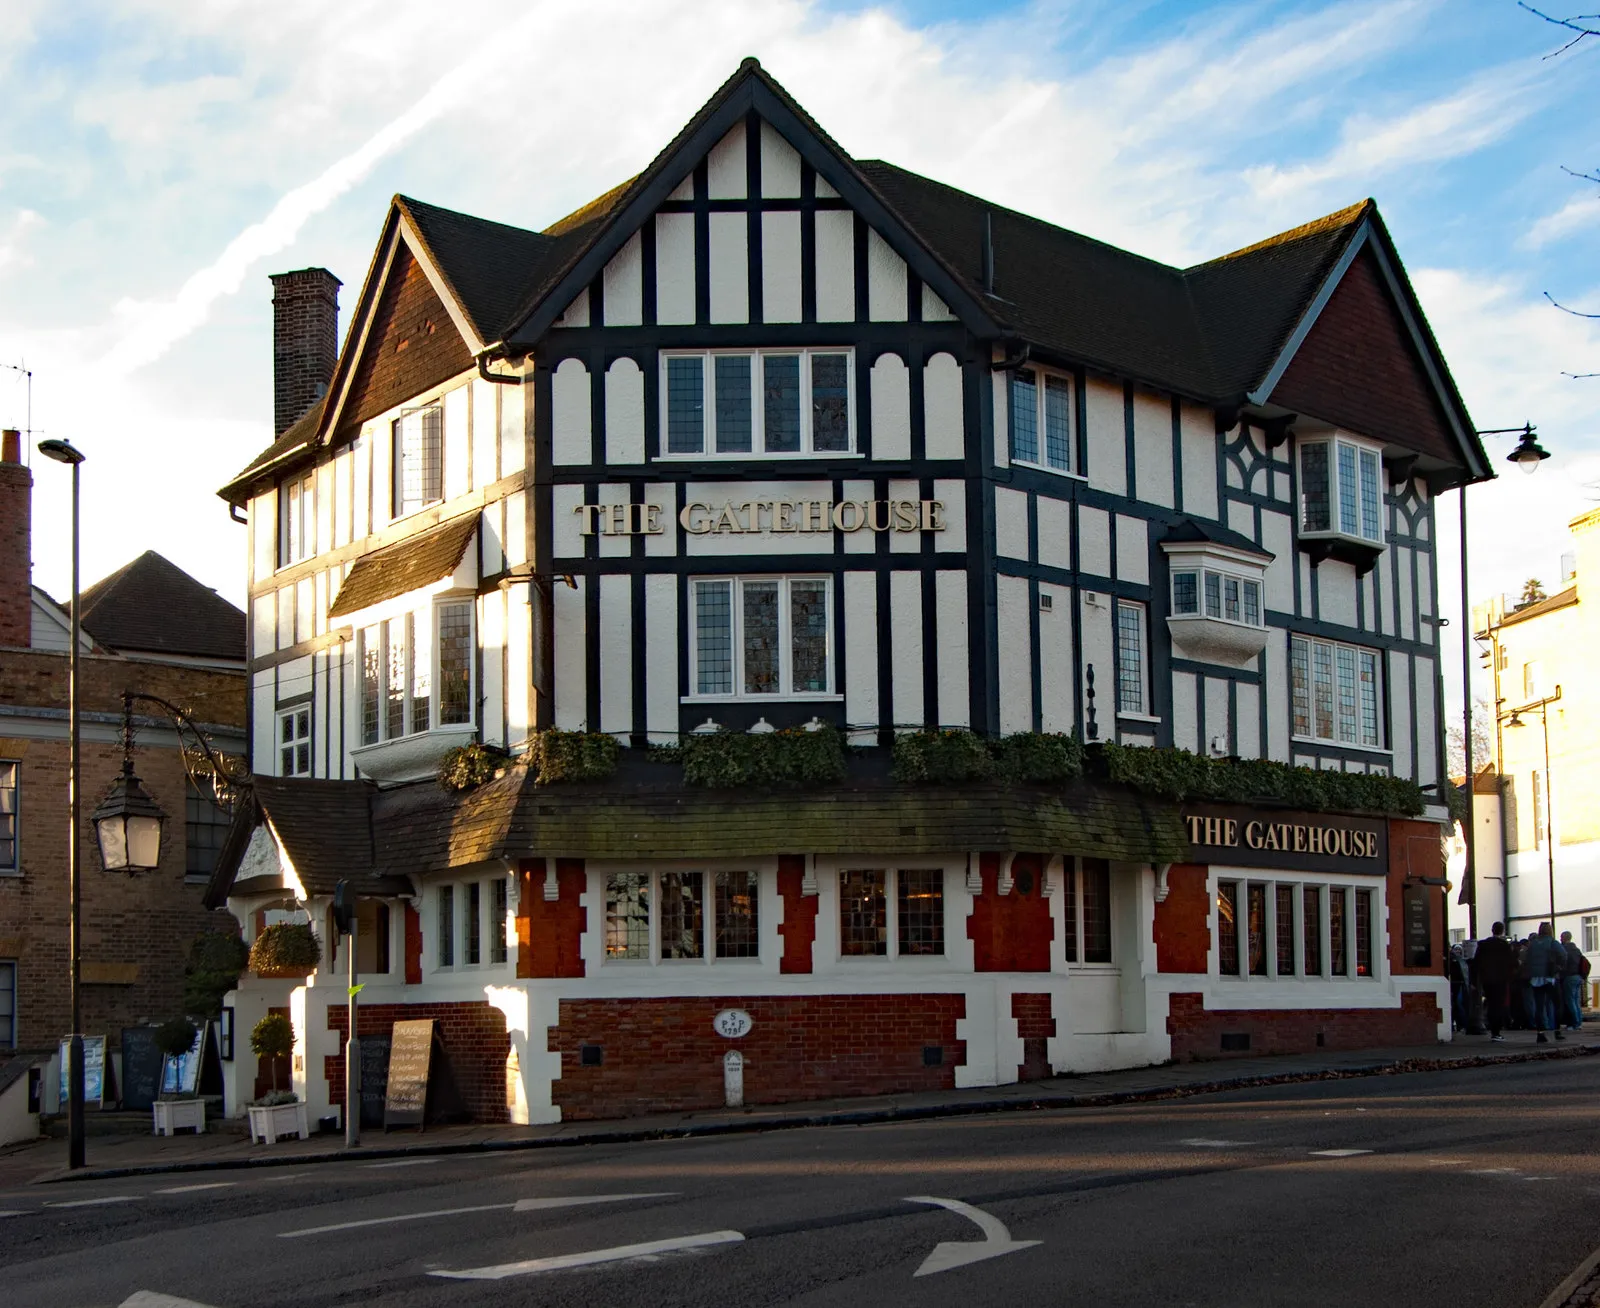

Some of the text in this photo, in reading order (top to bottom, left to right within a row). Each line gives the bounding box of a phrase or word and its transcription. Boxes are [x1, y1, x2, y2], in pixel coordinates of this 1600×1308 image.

[573, 500, 946, 535] THE GATEHOUSE
[1186, 816, 1379, 858] THE GATEHOUSE
[722, 1020, 744, 1028] P P
[730, 1012, 736, 1020] S
